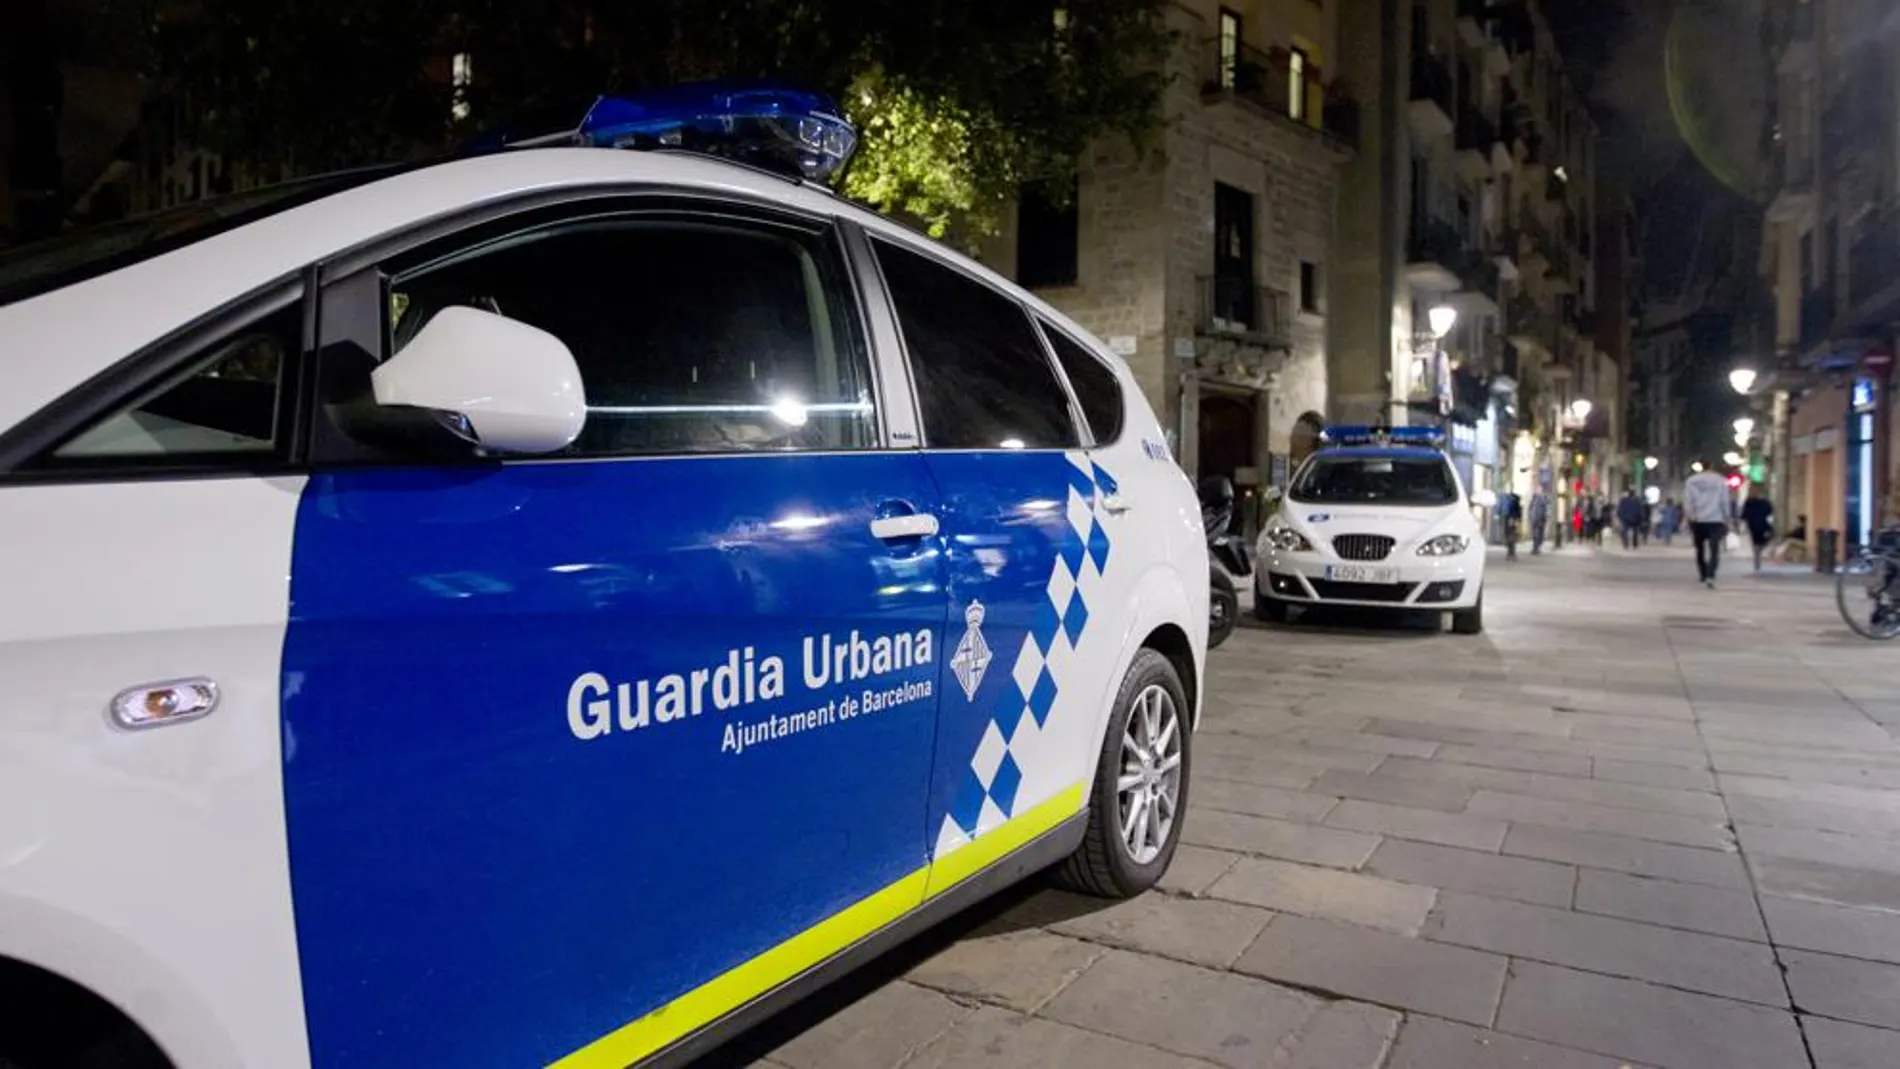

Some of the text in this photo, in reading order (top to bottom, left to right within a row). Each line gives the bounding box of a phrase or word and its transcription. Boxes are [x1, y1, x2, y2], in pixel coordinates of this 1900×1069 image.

[566, 628, 933, 740] Guardia Urbana
[721, 679, 932, 754] Ajuntament de Barcelona
